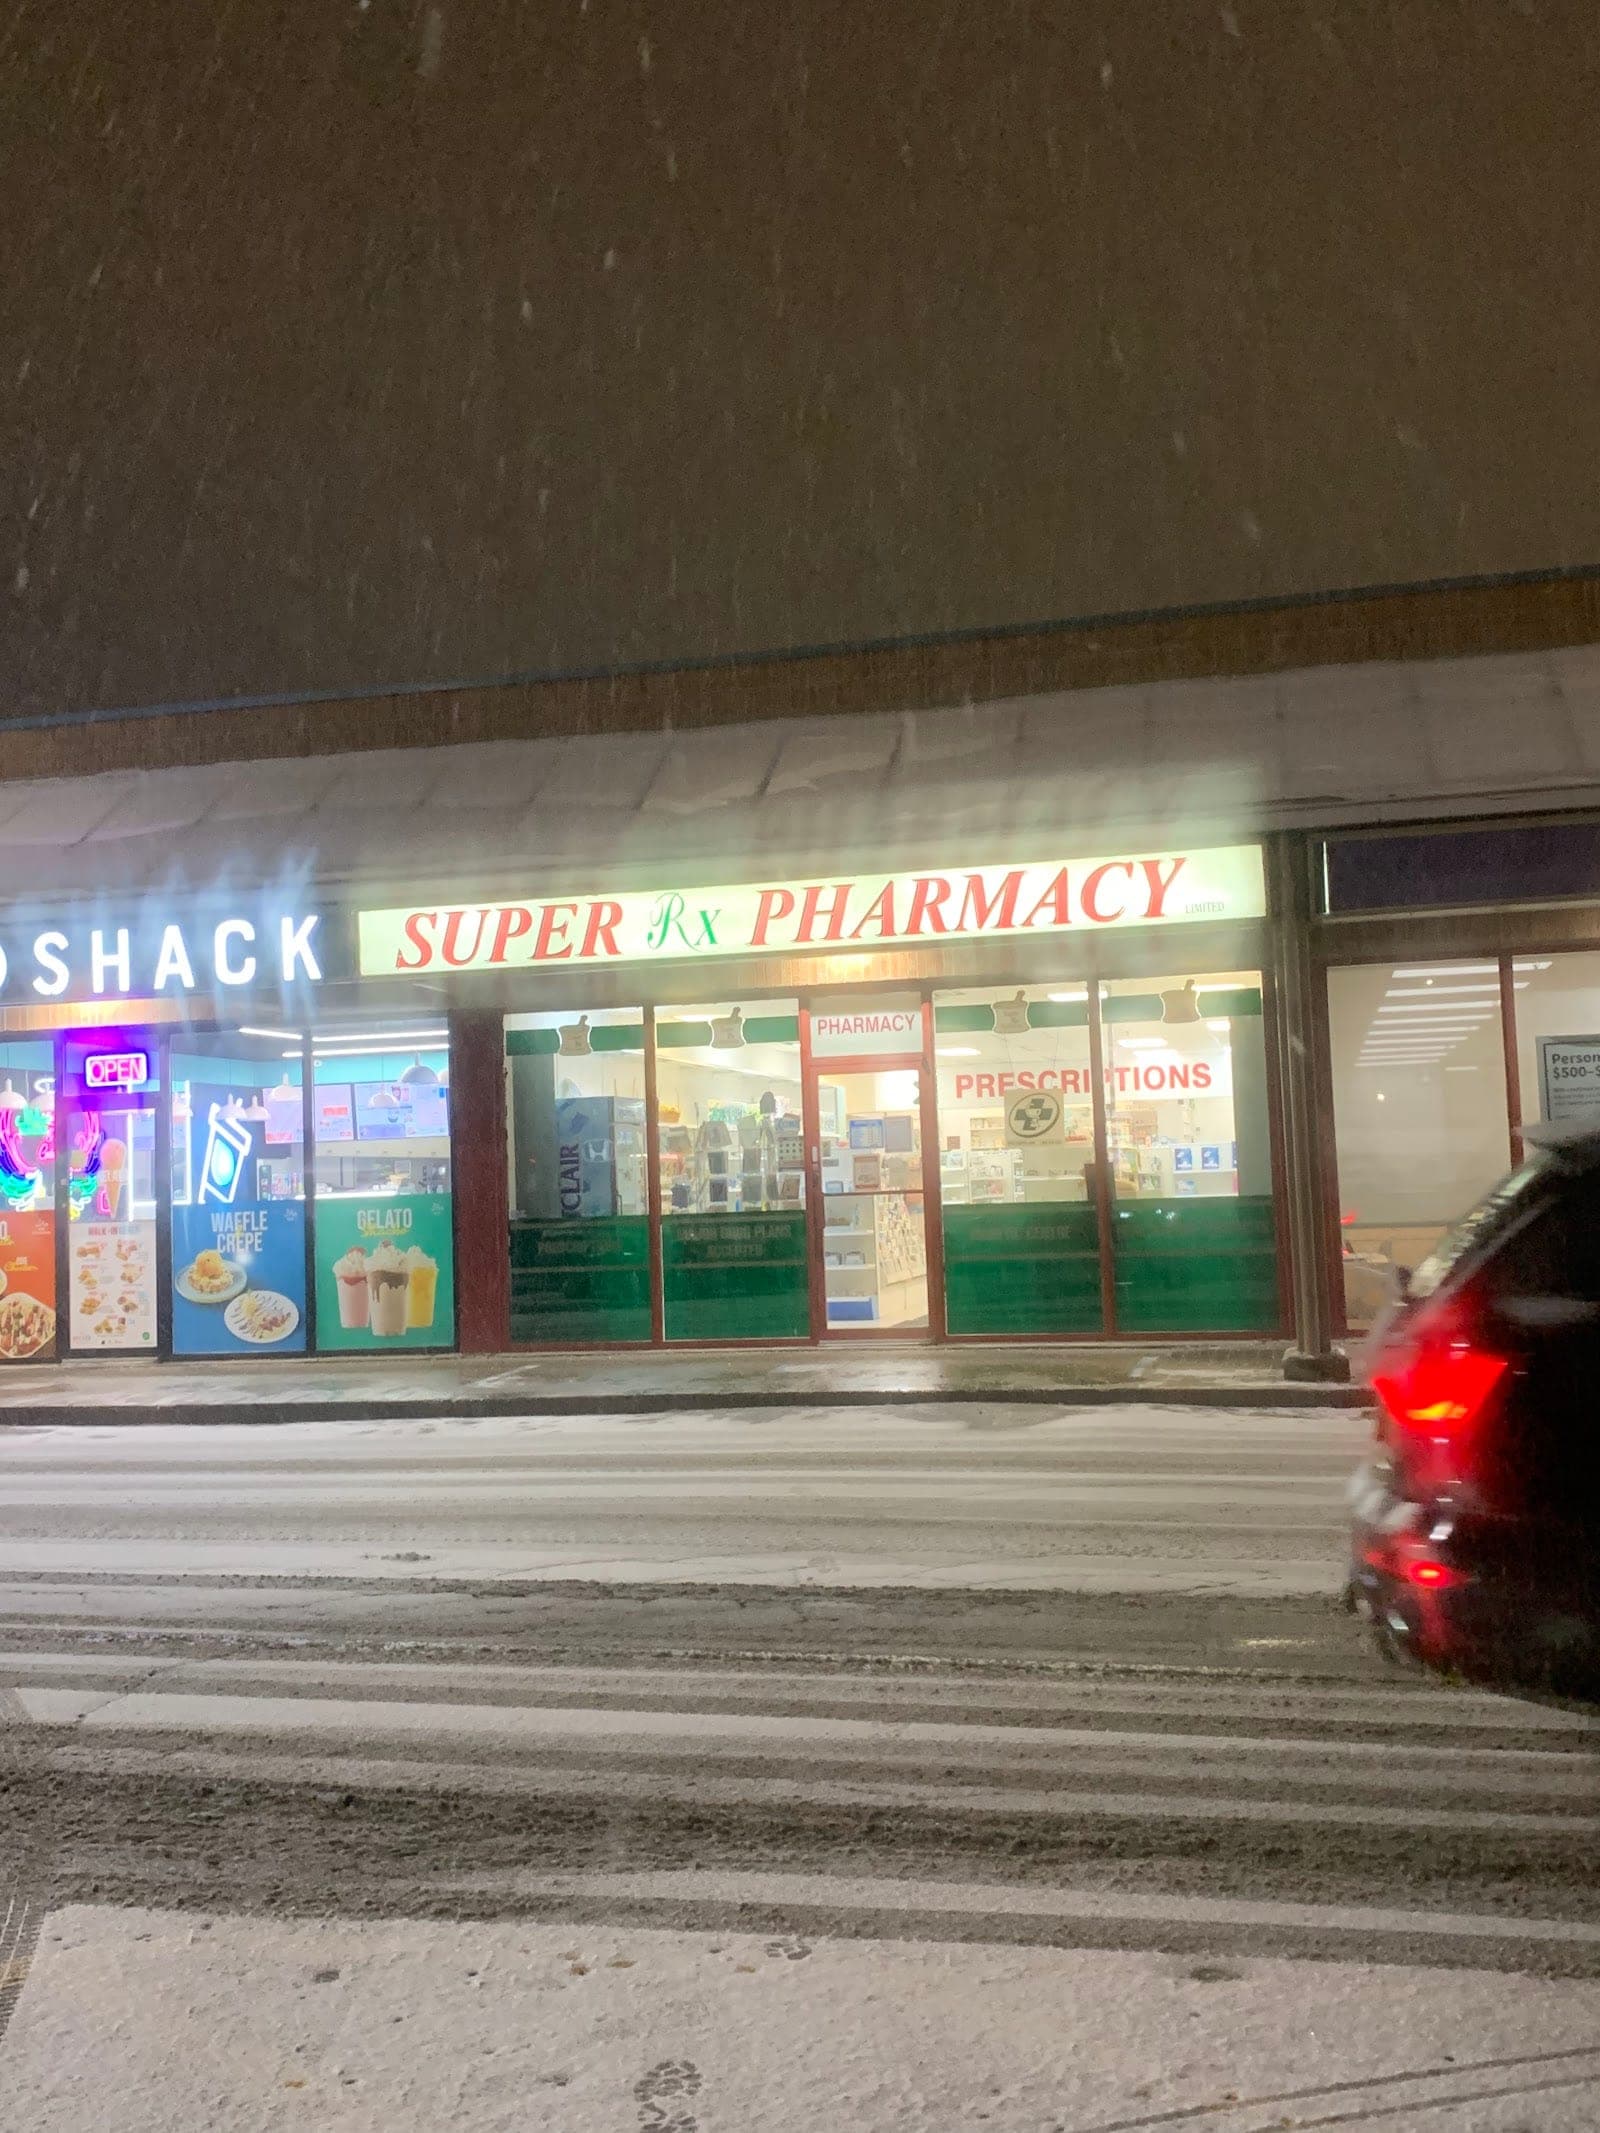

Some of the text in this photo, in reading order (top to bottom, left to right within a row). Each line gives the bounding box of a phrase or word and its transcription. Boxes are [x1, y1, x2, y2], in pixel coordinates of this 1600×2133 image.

[396, 858, 1186, 970] SUPER Rx PHARMACY
[1185, 902, 1225, 914] LIMITED
[33, 915, 322, 995] SHACK
[817, 1014, 915, 1035] PHARMACY
[90, 1057, 143, 1082] OPEN
[955, 1062, 1212, 1098] PRESCRITIONS
[211, 1210, 268, 1233] WAFFLE
[357, 1208, 412, 1231] GELATO
